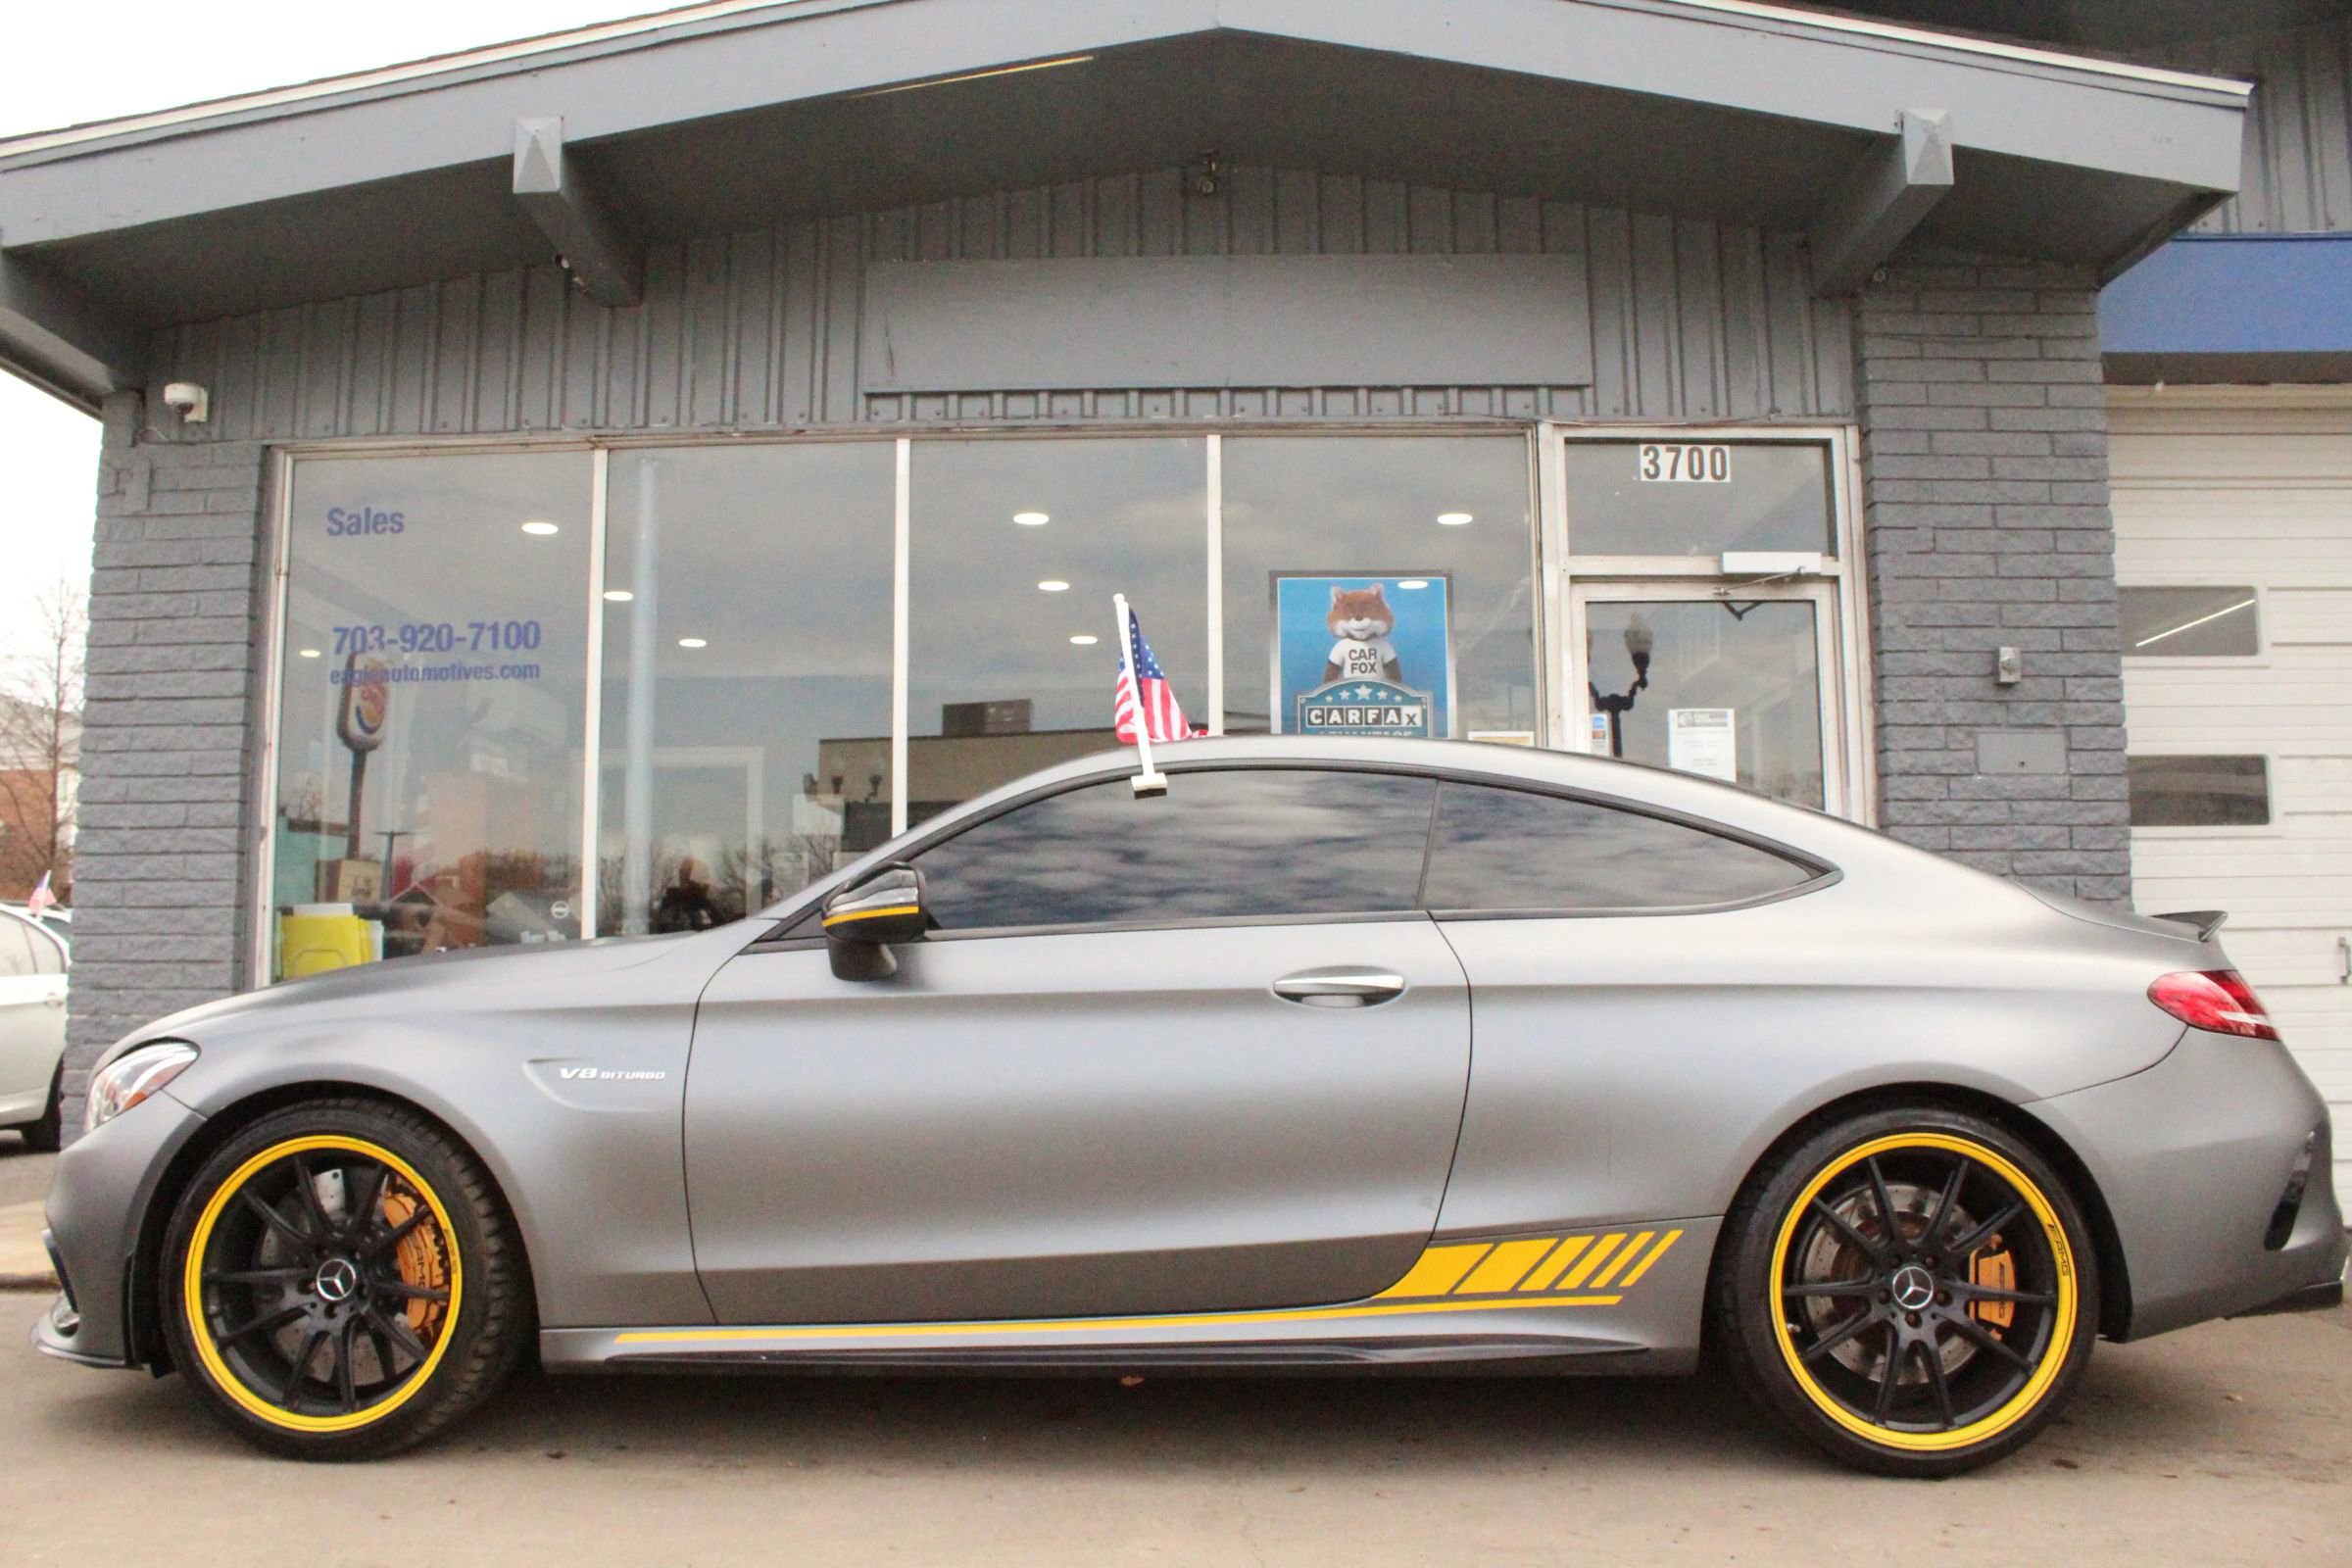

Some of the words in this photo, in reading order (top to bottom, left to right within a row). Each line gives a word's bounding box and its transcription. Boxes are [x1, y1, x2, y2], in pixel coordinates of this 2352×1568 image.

[1643, 446, 1727, 480] 3700
[327, 507, 405, 536] Sales
[333, 620, 541, 655] 703-920-7100
[1348, 649, 1377, 661] CAR
[1350, 662, 1377, 674] FOX
[561, 1068, 598, 1079] V8
[601, 1071, 665, 1080] BITURBO
